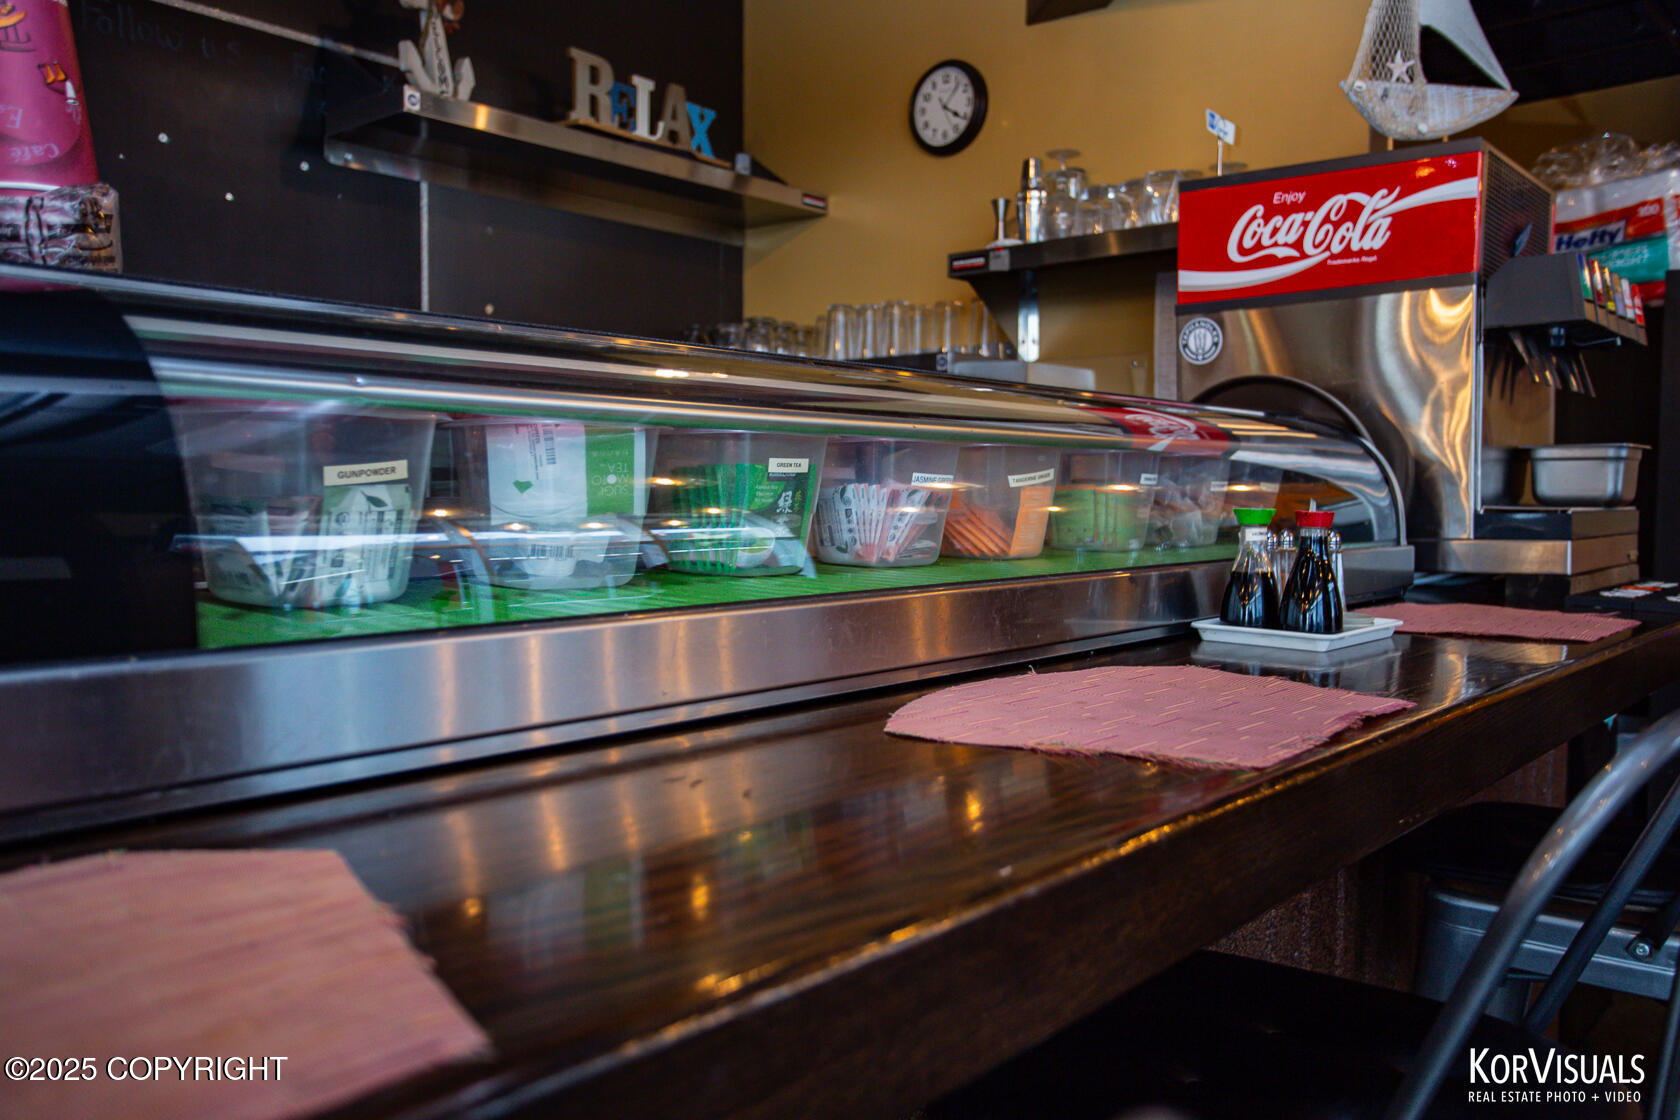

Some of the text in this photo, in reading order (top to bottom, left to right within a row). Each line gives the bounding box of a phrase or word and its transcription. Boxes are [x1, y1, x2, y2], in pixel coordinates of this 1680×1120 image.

[567, 46, 717, 158] RELAX
[1273, 191, 1306, 205] Enjoy
[1227, 186, 1400, 263] Coca-Cola
[1556, 228, 1621, 252] Hefty
[337, 466, 396, 479] GUNPOWDER
